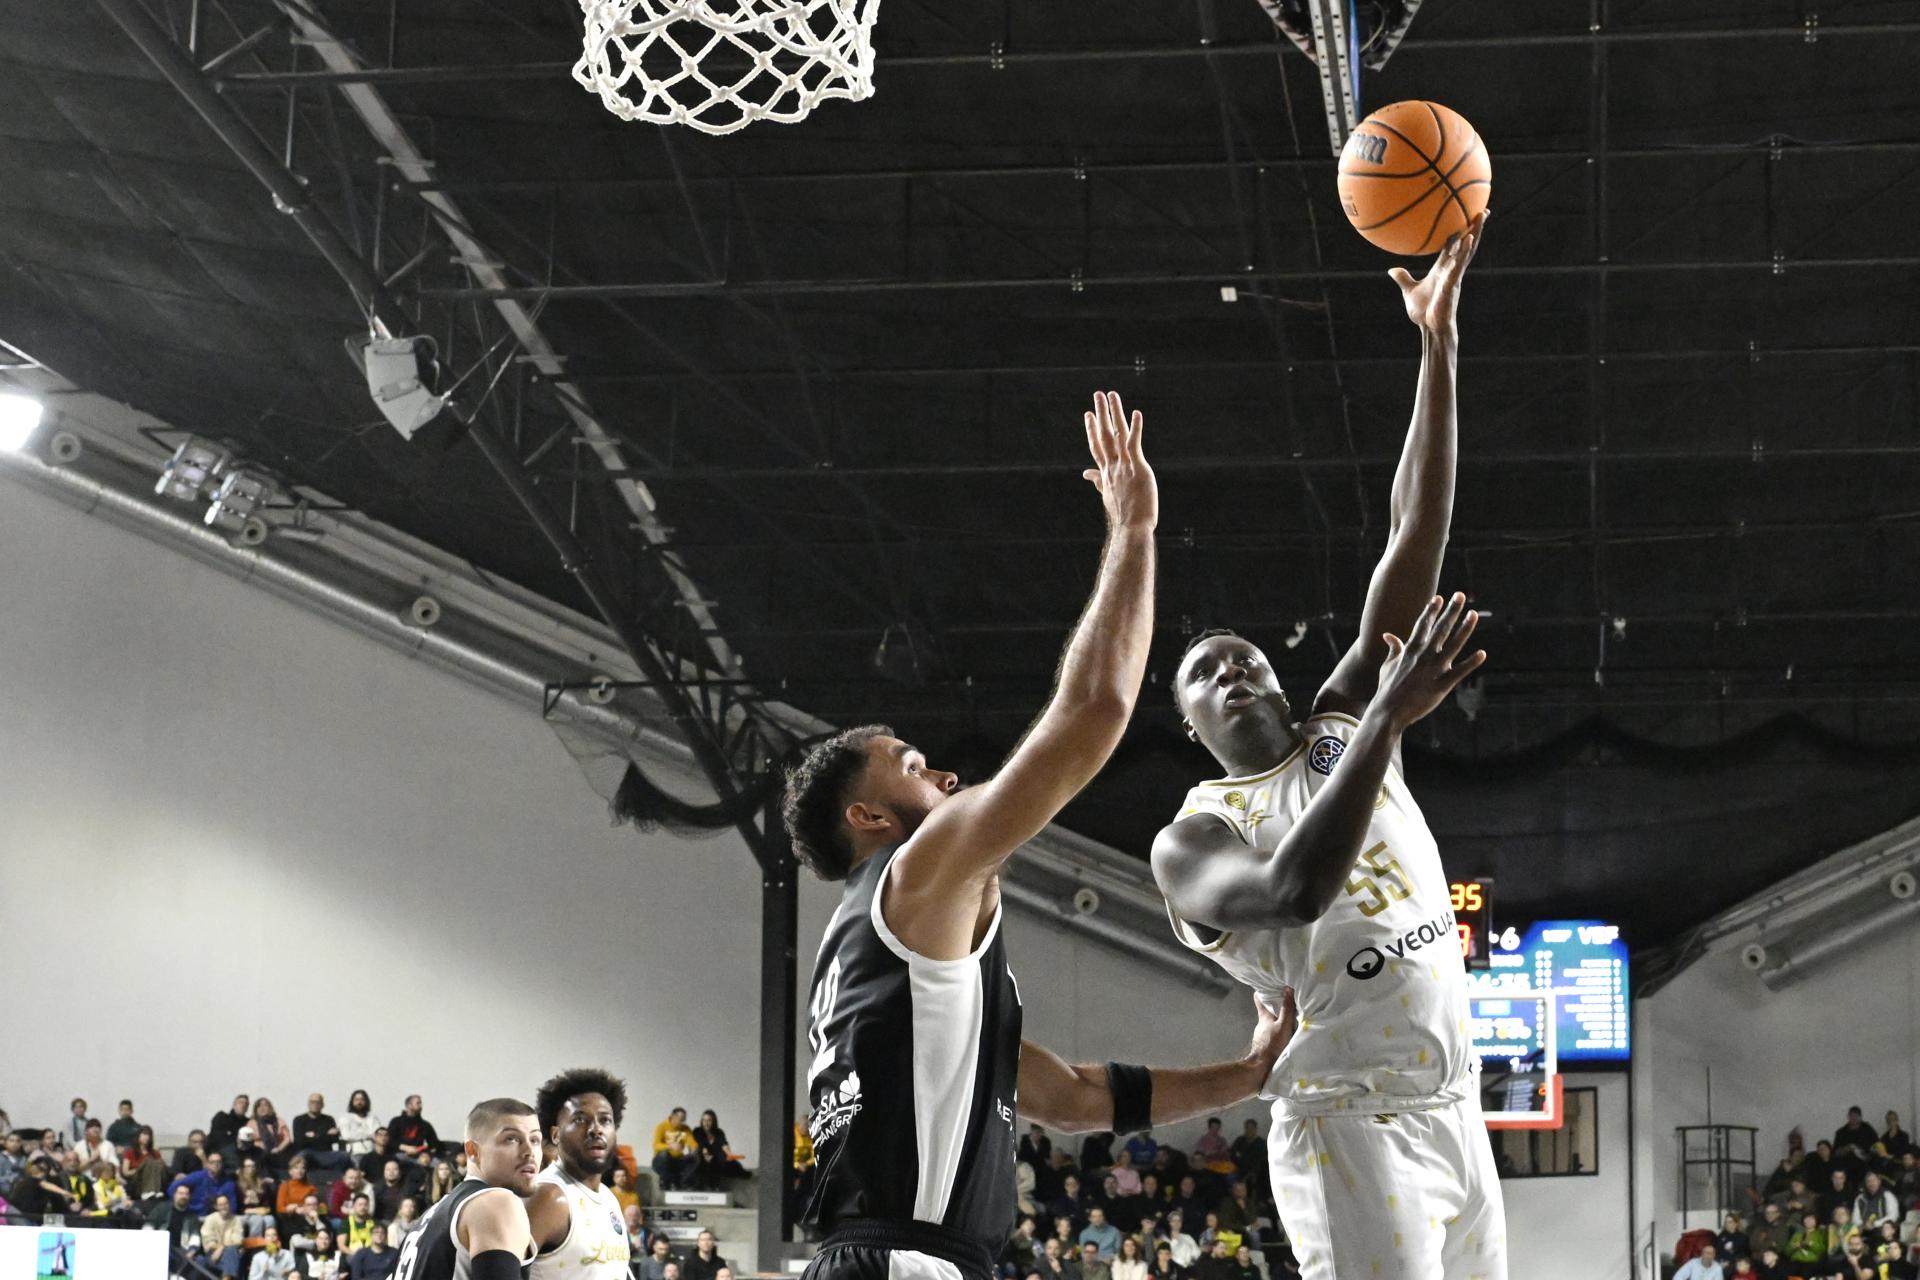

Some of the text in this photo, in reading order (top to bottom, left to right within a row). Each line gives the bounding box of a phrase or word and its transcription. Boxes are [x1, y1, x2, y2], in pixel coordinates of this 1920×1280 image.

[1344, 840, 1414, 917] 55
[1450, 883, 1482, 911] 35
[1385, 912, 1453, 958] VEOLIA
